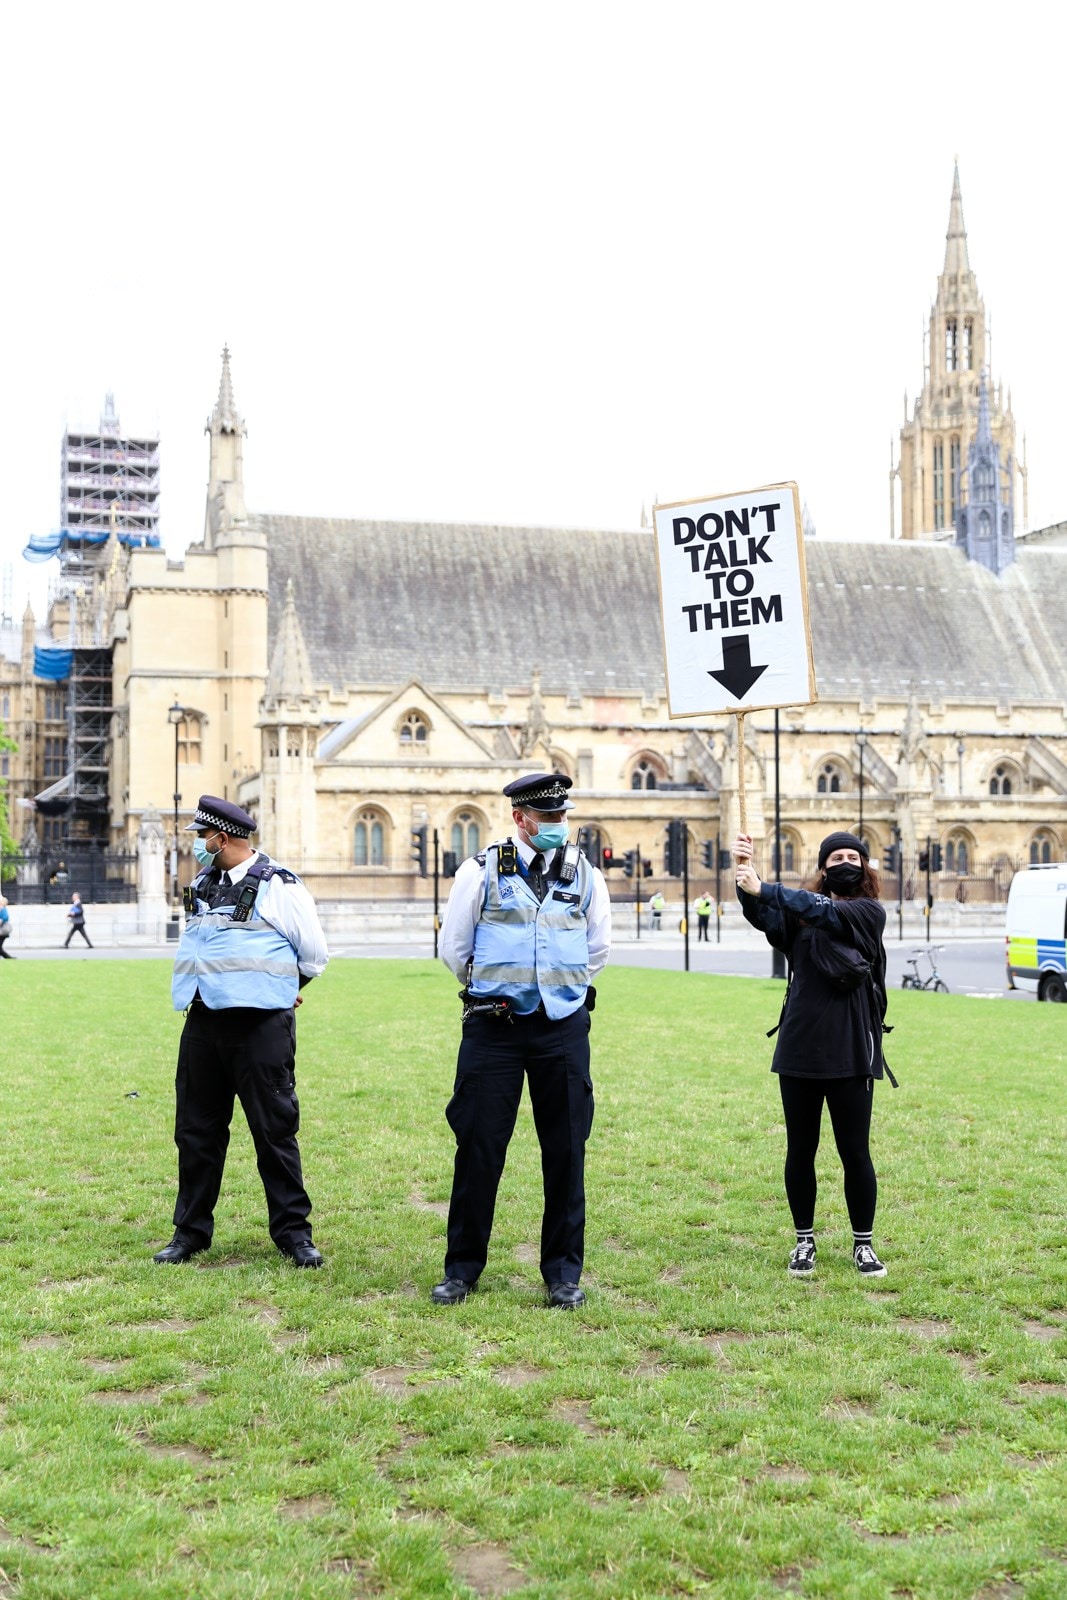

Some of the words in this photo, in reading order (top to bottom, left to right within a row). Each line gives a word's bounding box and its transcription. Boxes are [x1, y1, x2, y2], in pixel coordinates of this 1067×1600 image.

[672, 503, 780, 545] DON'T
[684, 535, 773, 573] TALK
[705, 568, 754, 600] TO
[682, 594, 783, 633] THEM
